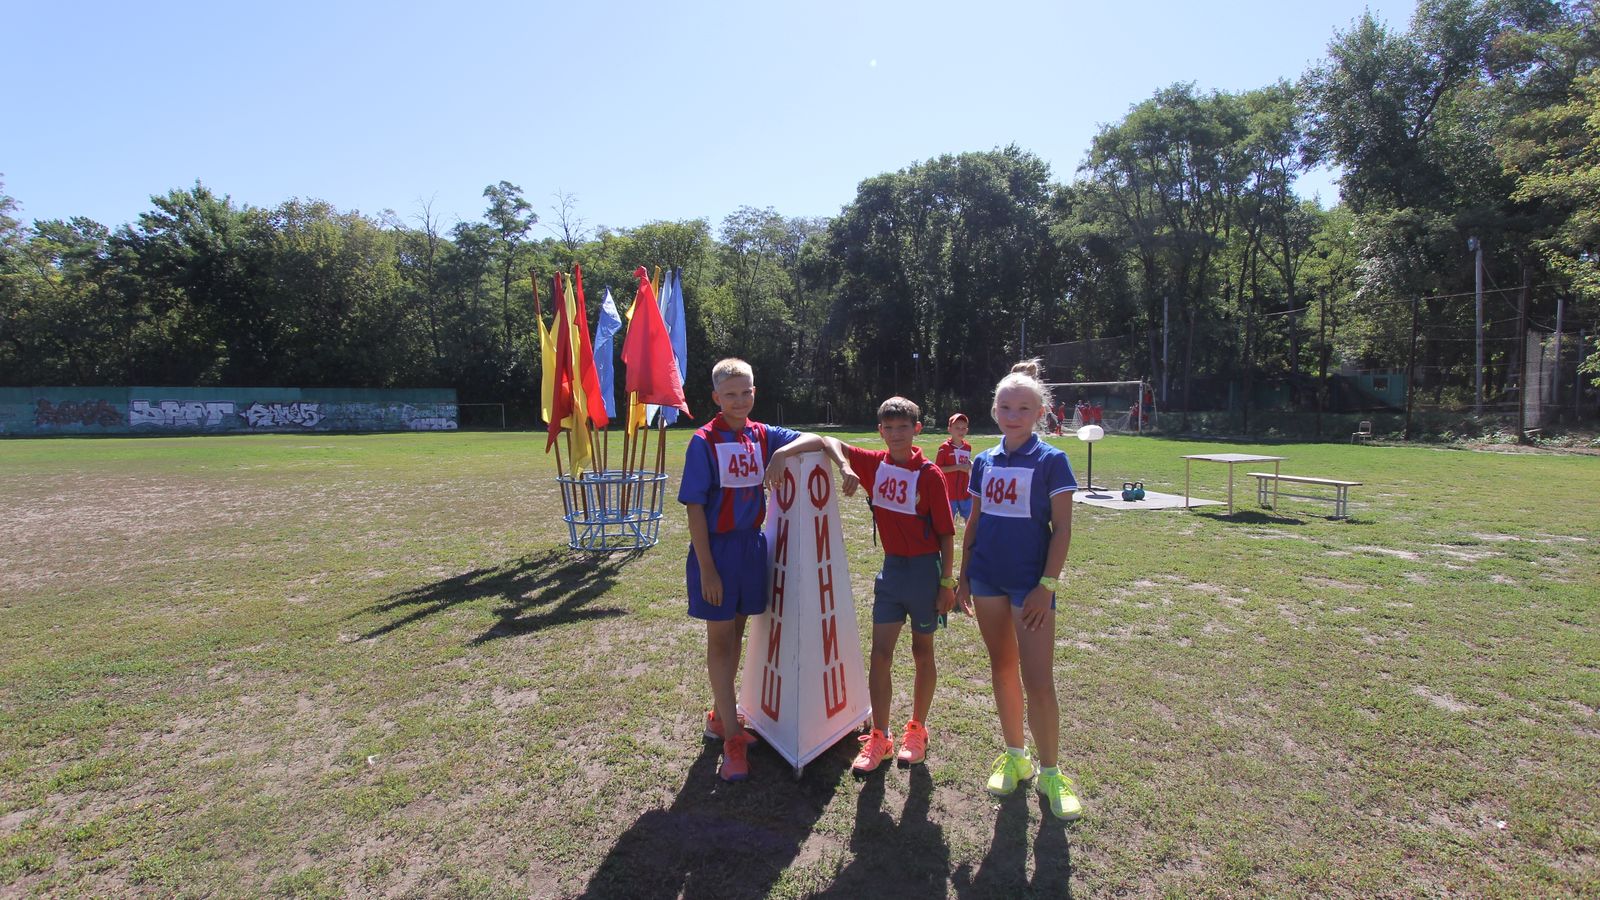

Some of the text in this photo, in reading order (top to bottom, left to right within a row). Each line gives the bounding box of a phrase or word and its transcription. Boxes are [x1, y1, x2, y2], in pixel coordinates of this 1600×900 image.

[729, 454, 758, 477] 454
[879, 476, 907, 504] 493
[986, 477, 1017, 504] 484
[761, 467, 796, 722] ФИНИШ
[808, 464, 847, 719] ФИНИШ
